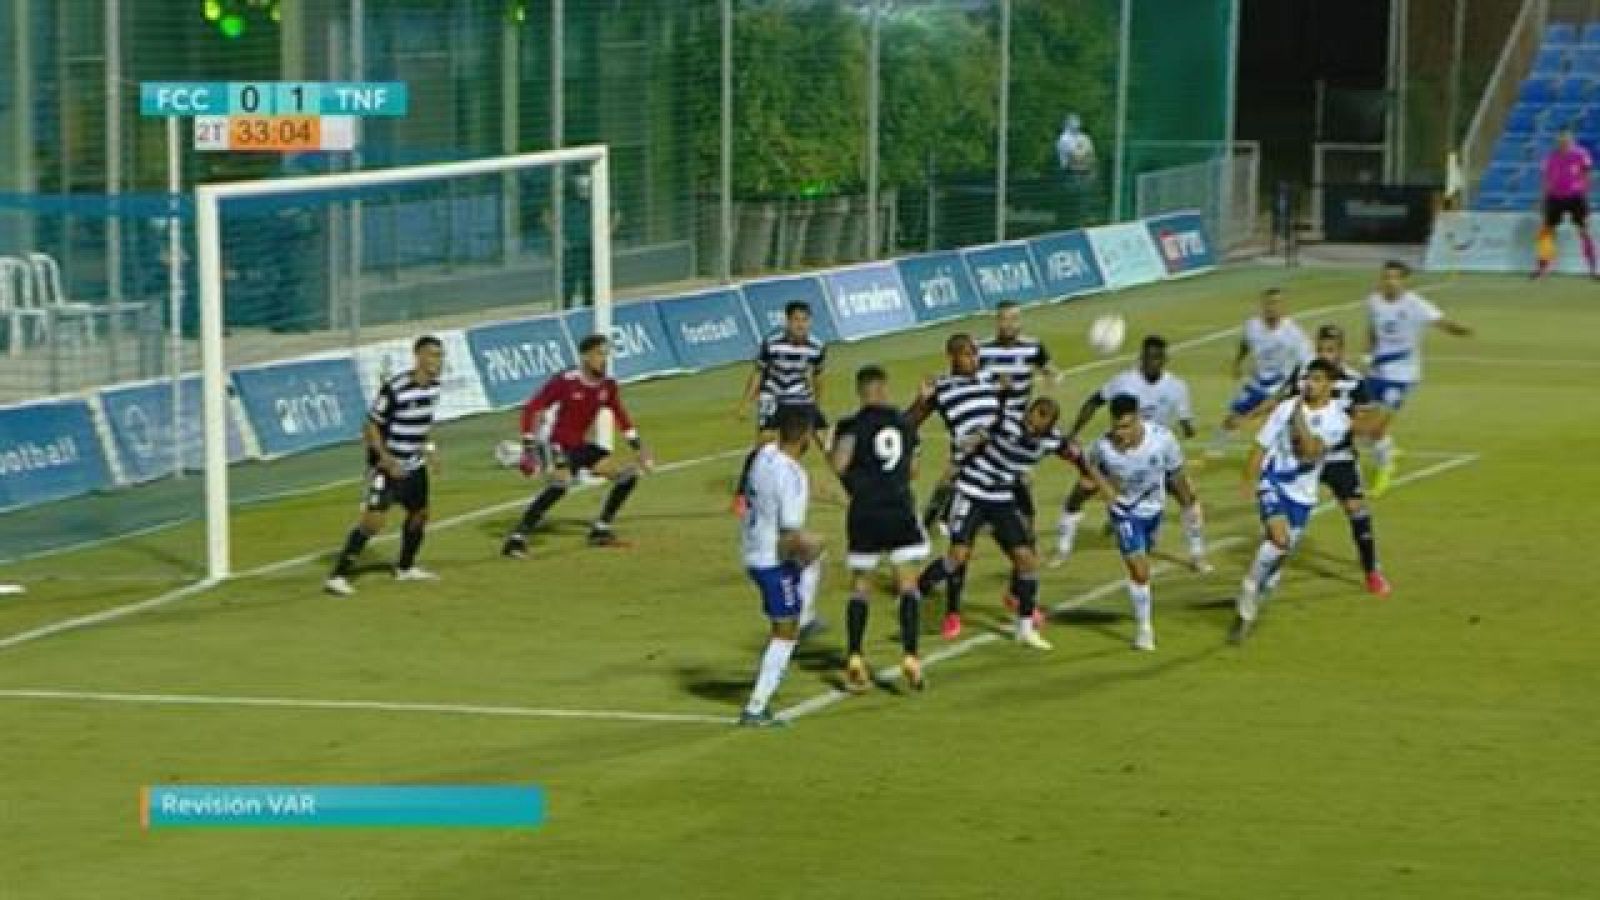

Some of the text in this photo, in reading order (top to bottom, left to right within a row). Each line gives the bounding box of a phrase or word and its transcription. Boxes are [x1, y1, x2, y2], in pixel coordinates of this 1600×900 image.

[481, 338, 566, 383] PNATAR
[274, 380, 342, 434] archi
[874, 427, 903, 471] 9
